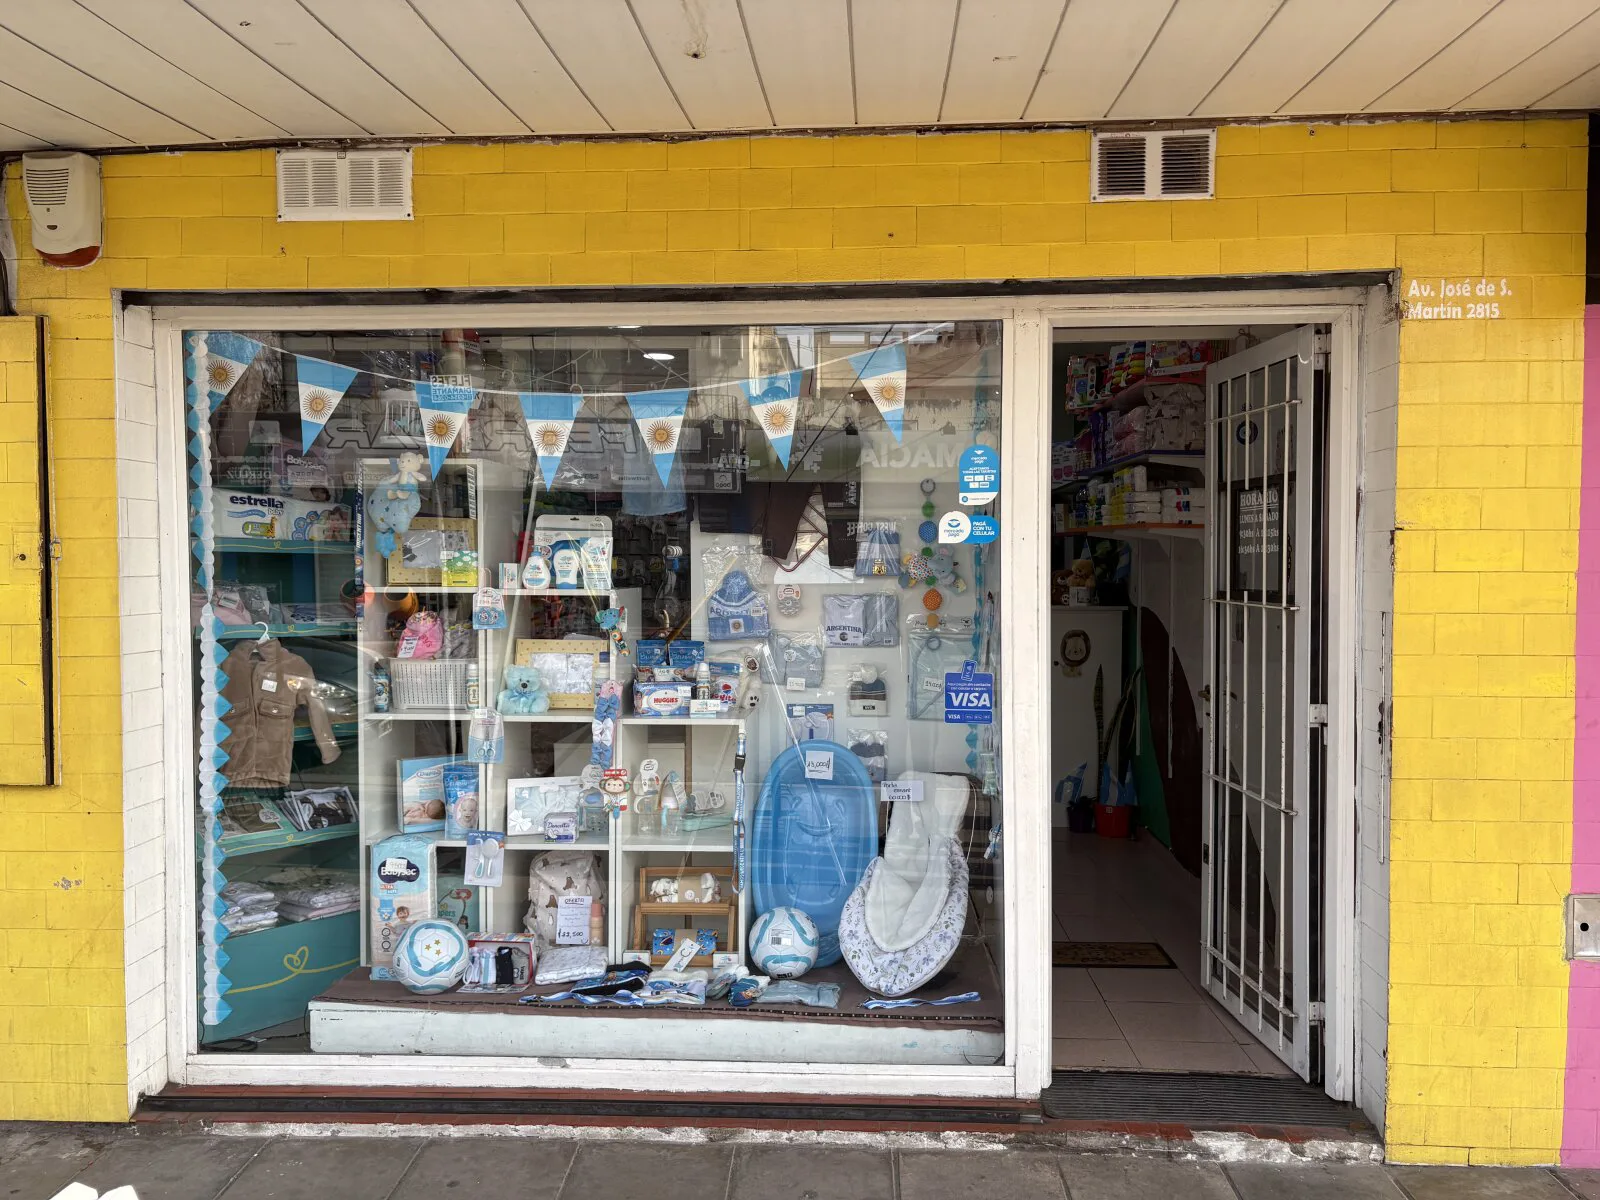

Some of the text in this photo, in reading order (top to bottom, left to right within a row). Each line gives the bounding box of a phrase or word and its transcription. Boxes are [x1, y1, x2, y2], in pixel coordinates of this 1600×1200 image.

[1408, 278, 1512, 298] Av. José de S.
[1407, 301, 1500, 319] Martín 2815
[229, 495, 284, 510] estrella
[826, 625, 863, 634] ARGENTINA
[947, 691, 991, 707] VISA
